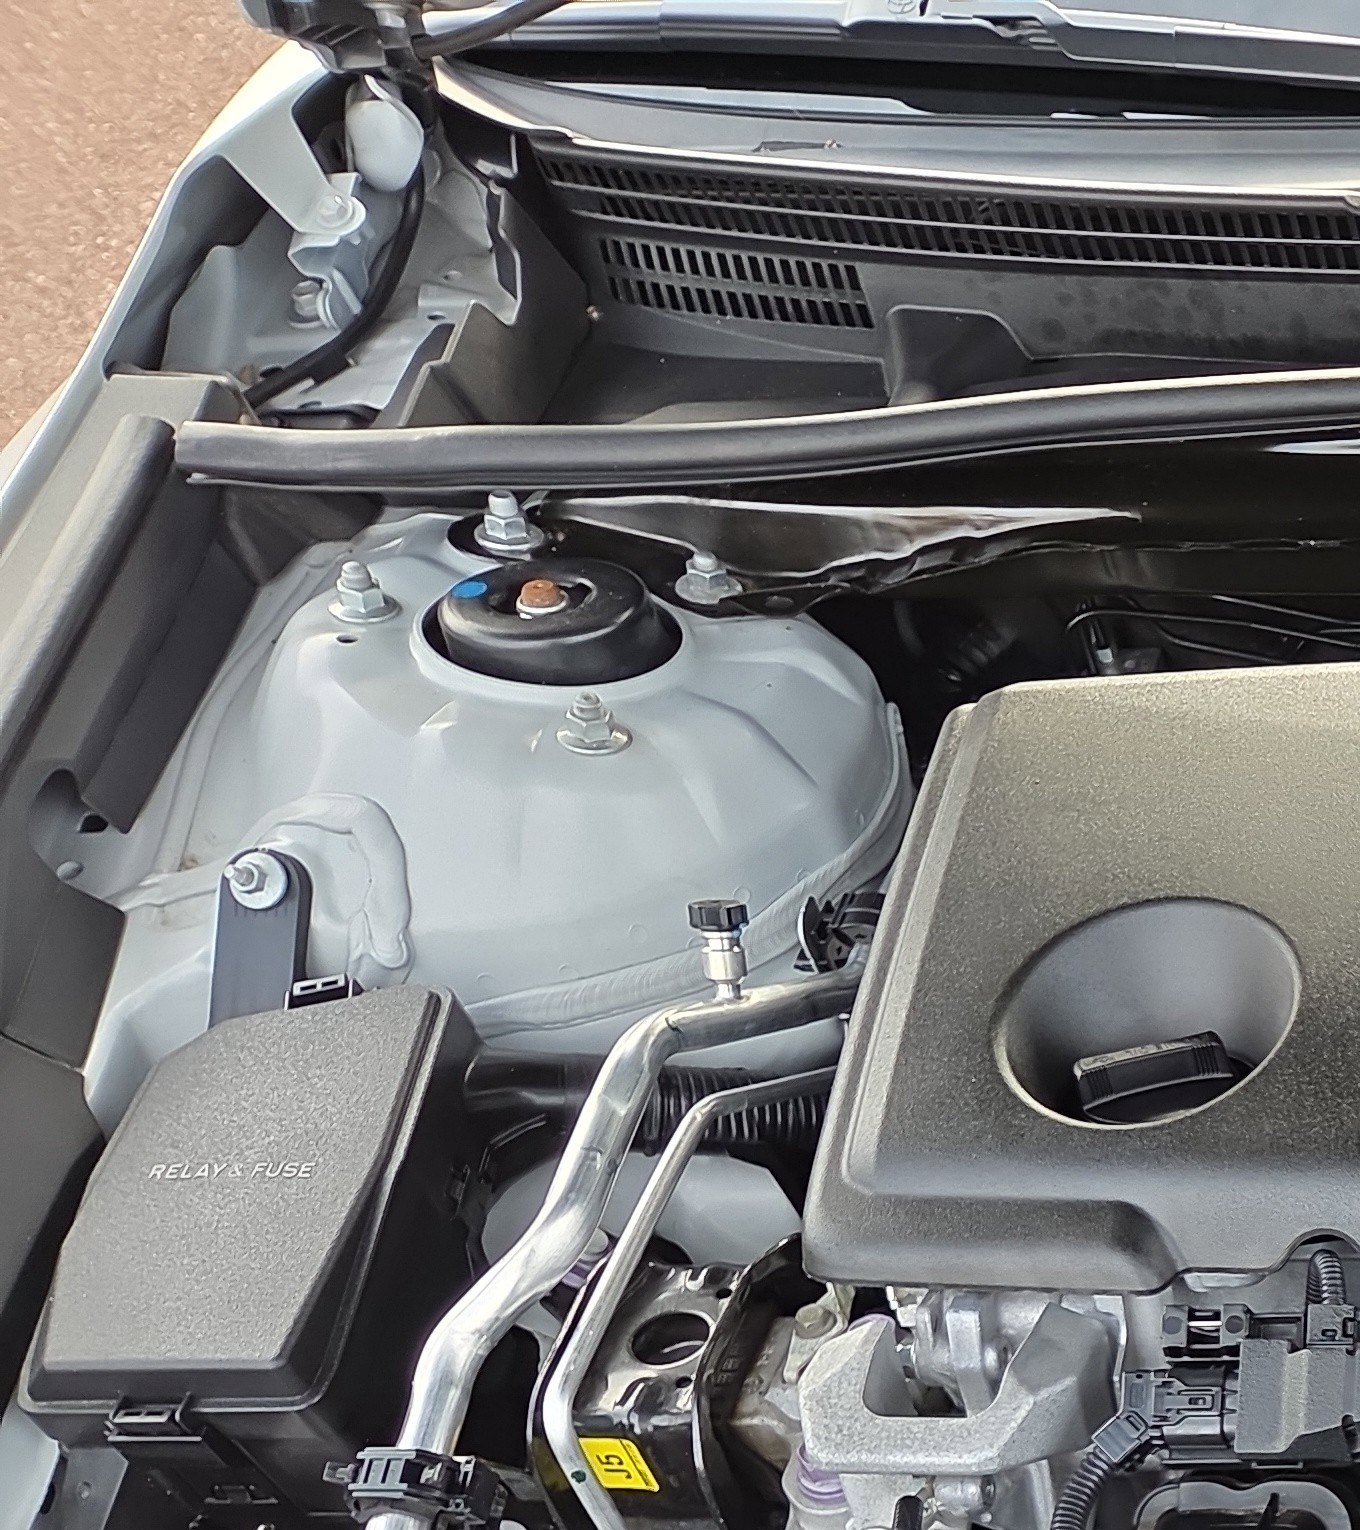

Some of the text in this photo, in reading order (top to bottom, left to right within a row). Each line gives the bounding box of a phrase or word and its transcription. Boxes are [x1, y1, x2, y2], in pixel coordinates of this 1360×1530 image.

[148, 1162, 316, 1180] RELAY & FUSE
[595, 1453, 633, 1479] J5
